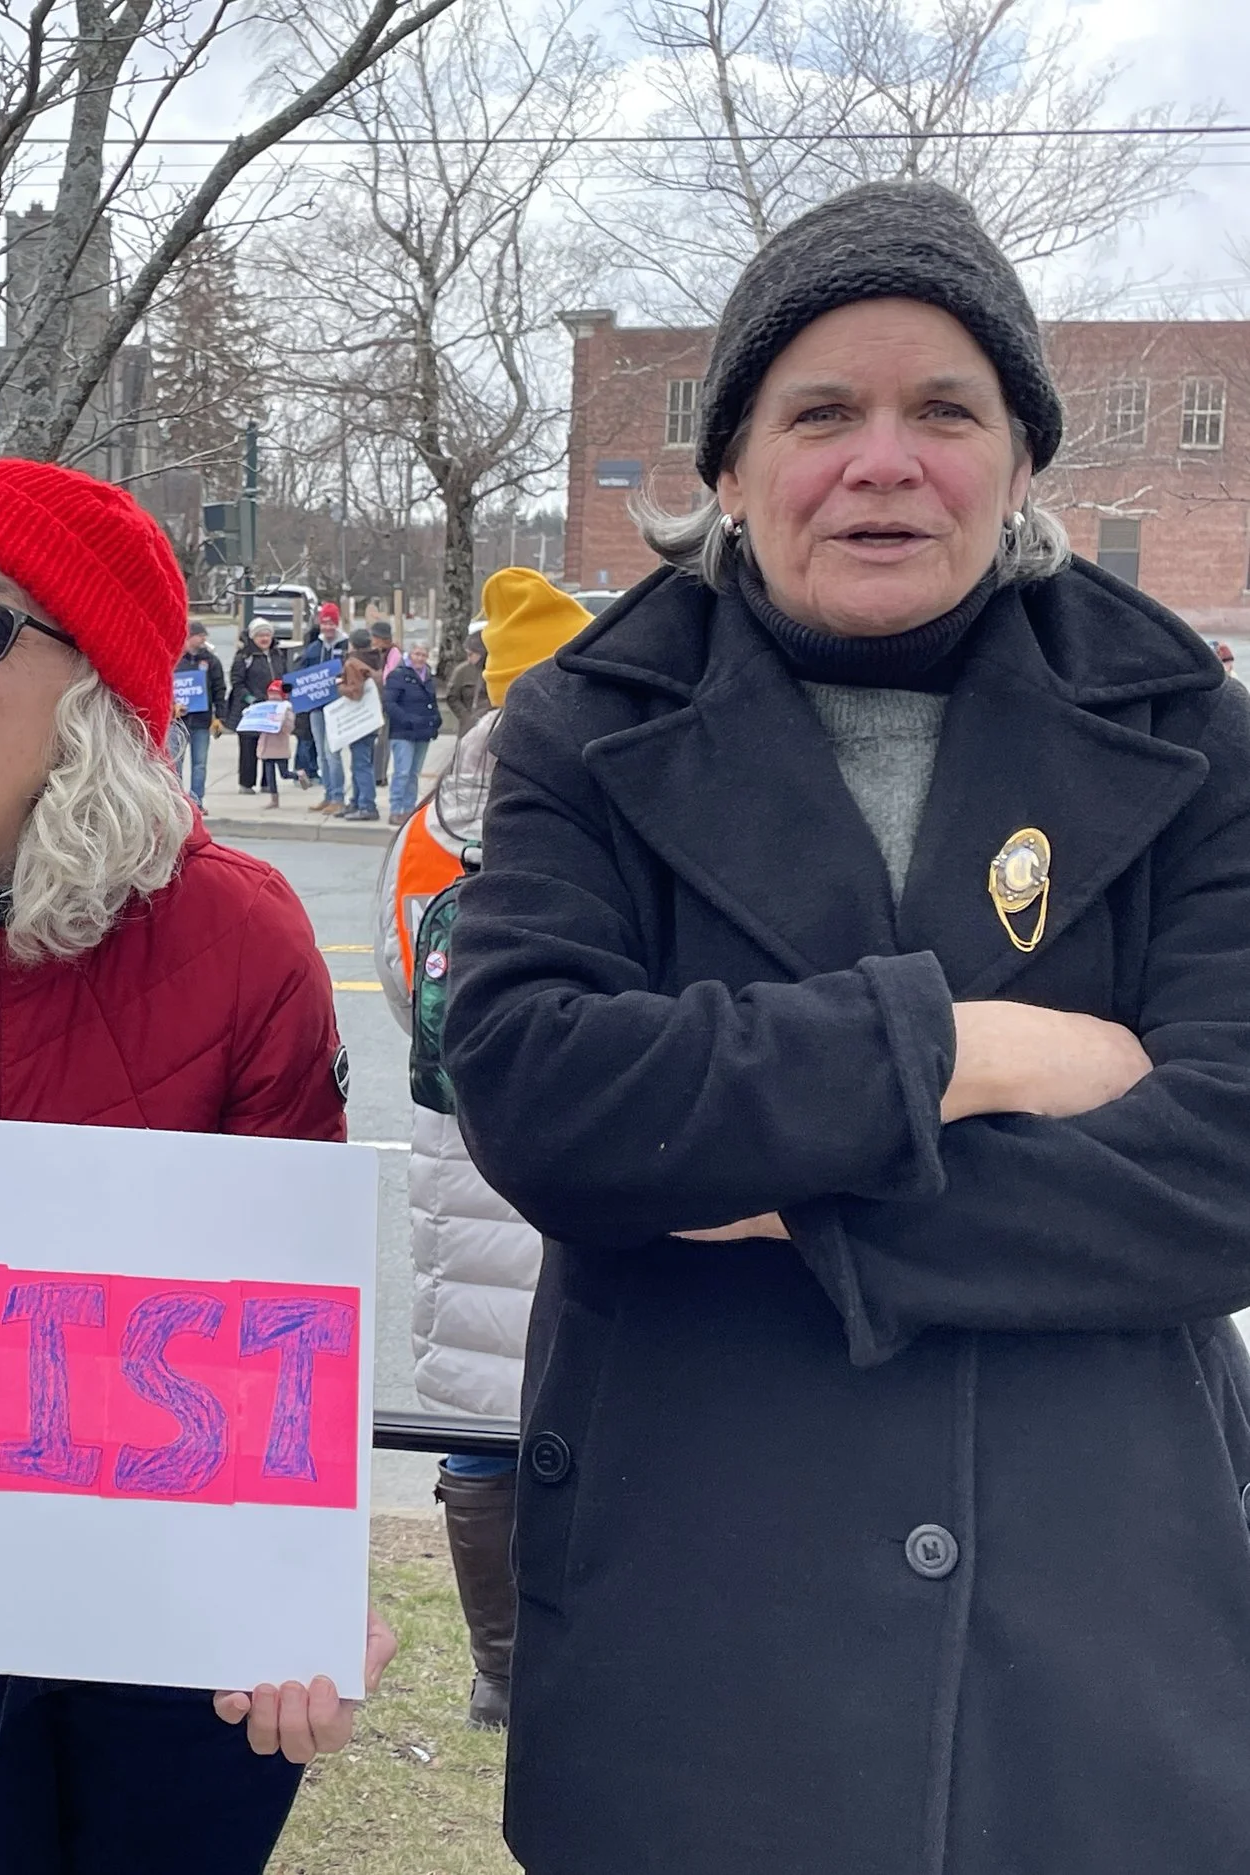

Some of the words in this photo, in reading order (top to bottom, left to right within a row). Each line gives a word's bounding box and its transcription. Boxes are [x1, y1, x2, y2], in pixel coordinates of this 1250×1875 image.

[173, 686, 203, 697] PORTS
[292, 677, 336, 698] SUPPORT
[307, 688, 330, 701] YOU
[175, 696, 190, 706] OU
